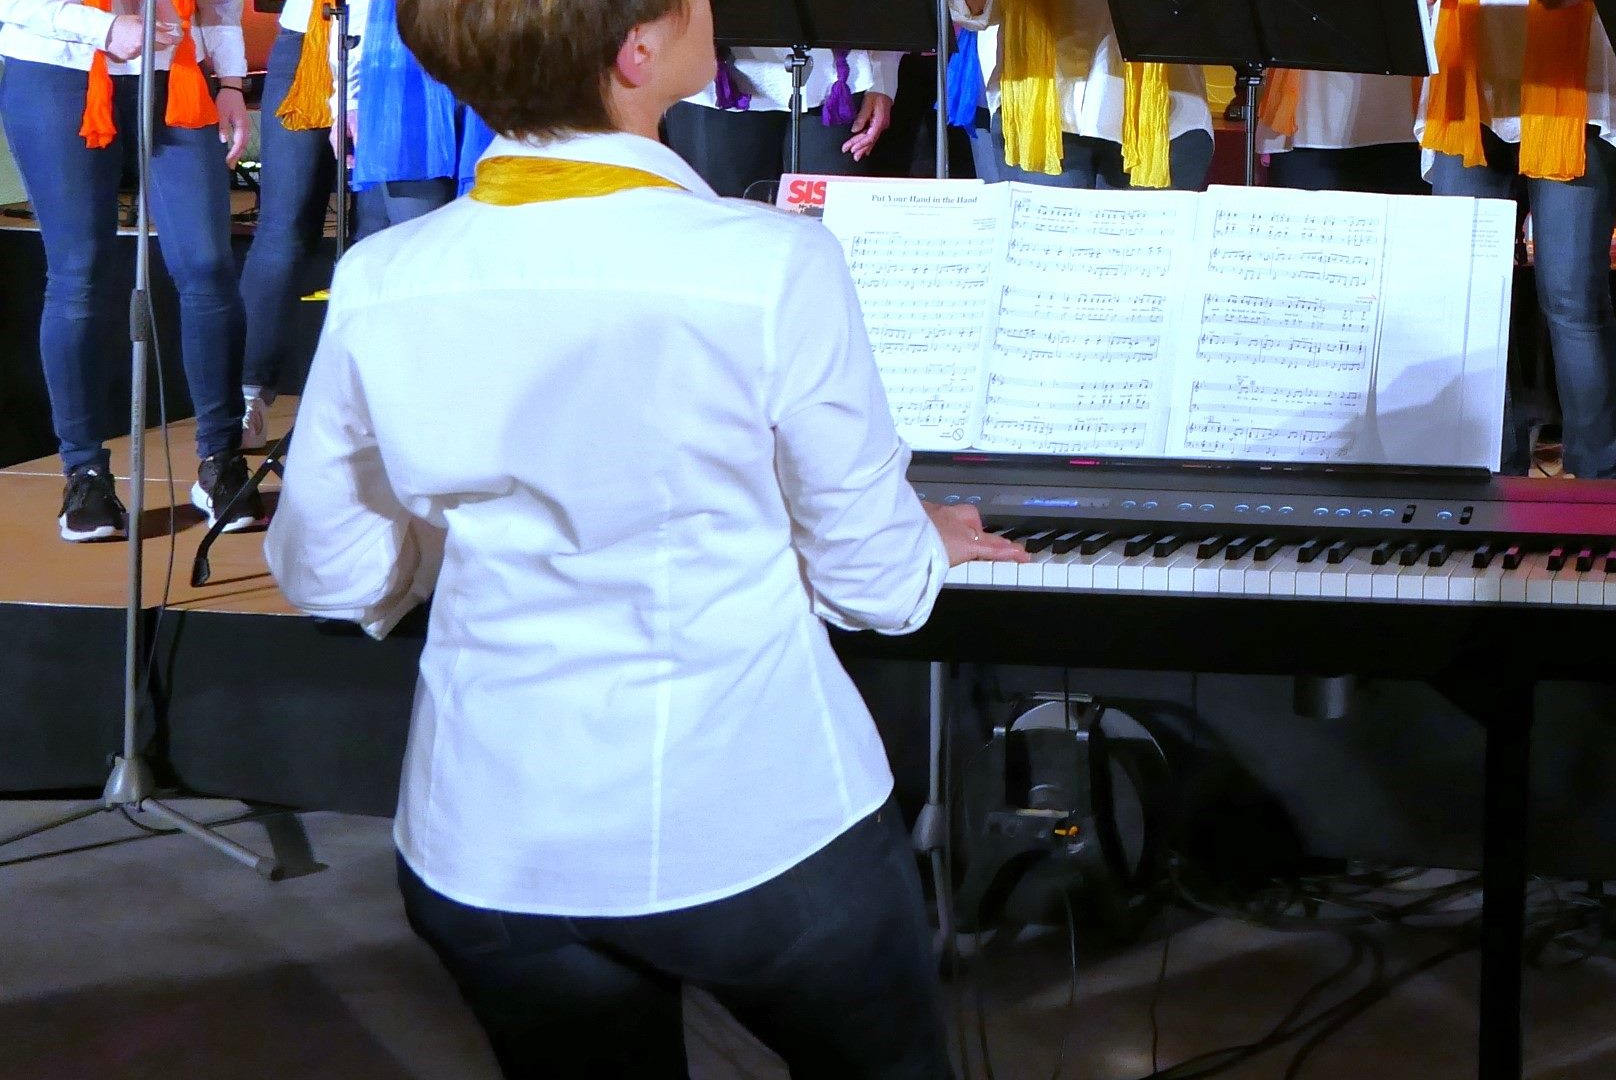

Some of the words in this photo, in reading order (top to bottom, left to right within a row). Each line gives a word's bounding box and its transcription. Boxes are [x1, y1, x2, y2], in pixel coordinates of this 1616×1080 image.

[871, 194, 886, 203] Put
[888, 194, 908, 203] Your
[909, 195, 931, 203] Hand
[932, 196, 941, 204] in
[942, 195, 955, 204] the
[956, 196, 978, 204] Hand
